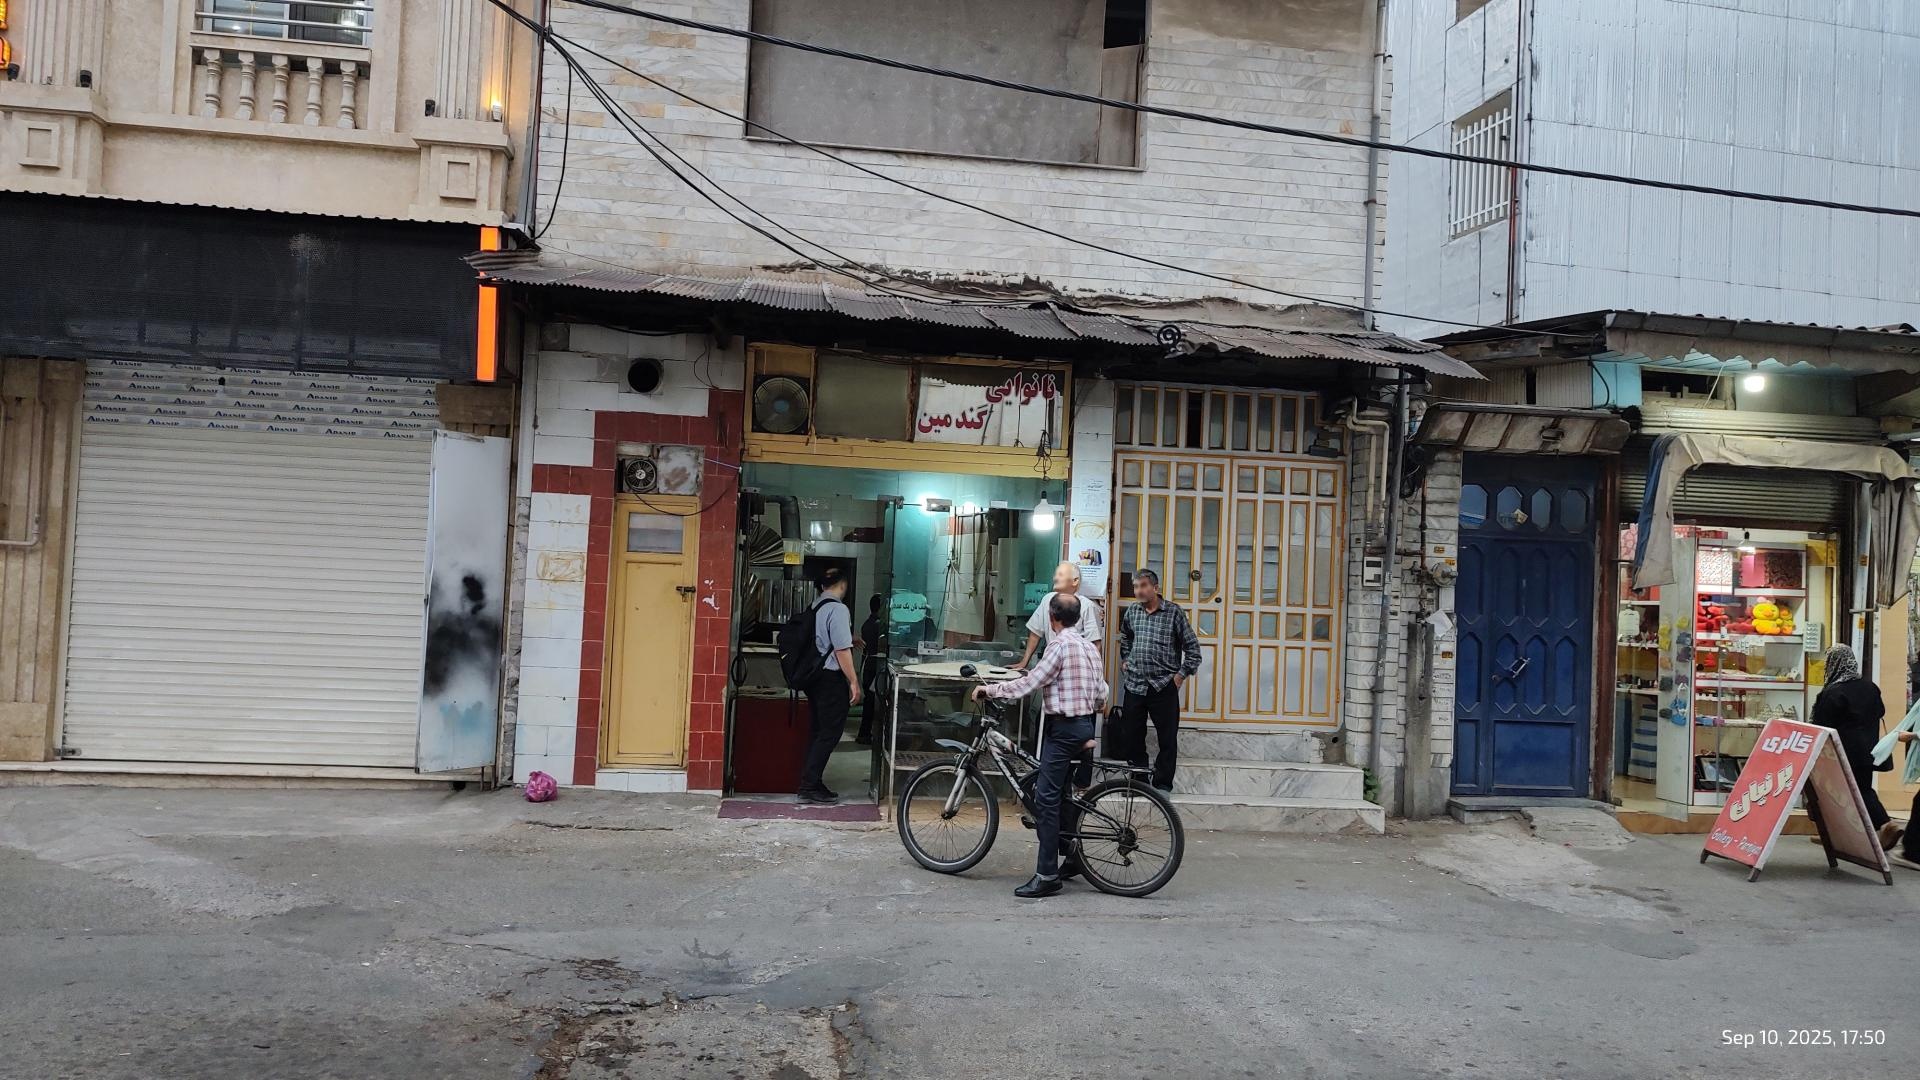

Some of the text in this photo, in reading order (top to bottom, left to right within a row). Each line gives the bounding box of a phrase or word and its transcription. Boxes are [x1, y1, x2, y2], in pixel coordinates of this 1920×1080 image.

[985, 368, 1056, 406] نانوایی
[1762, 730, 1814, 754] گالری
[1730, 763, 1794, 822] پرنیان
